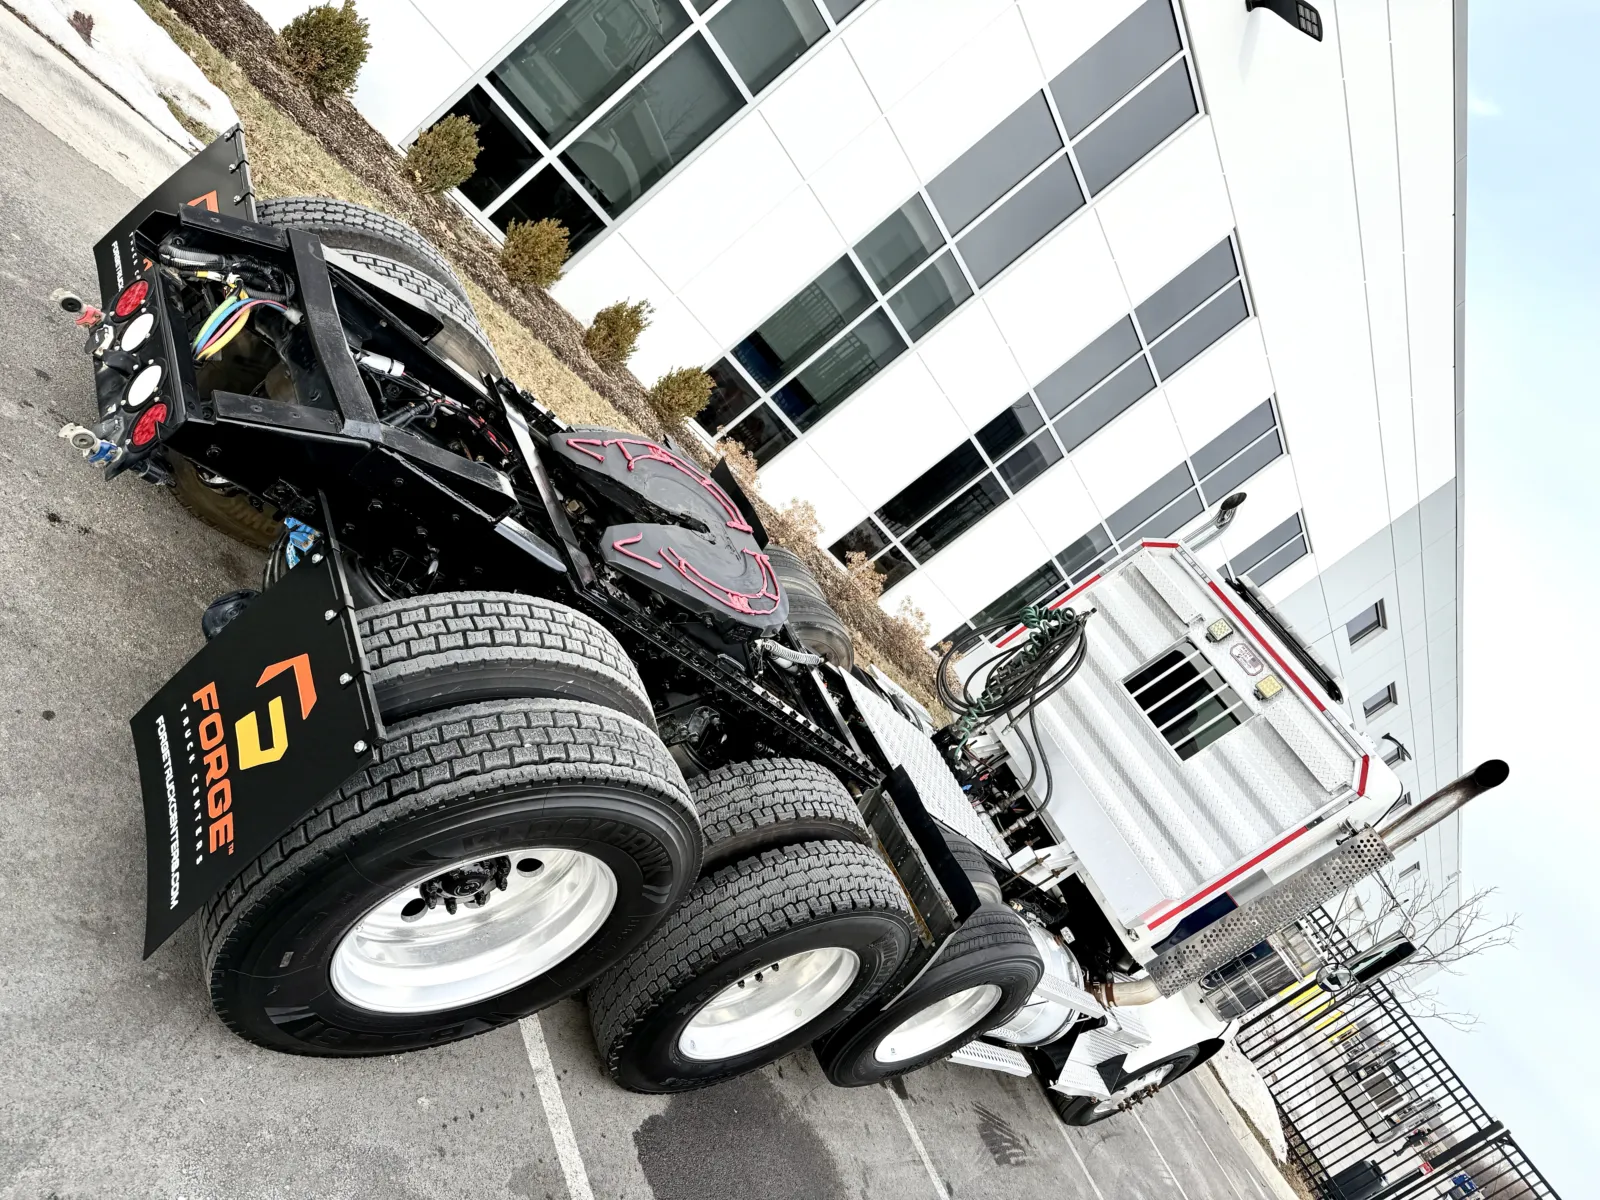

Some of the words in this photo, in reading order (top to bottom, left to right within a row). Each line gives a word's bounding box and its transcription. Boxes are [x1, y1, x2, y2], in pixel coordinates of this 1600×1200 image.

[155, 715, 180, 910] FORGETRUCKCENTERS.COM
[180, 703, 196, 764] TRUCK
[191, 773, 203, 865] CENTERS
[192, 681, 234, 854] FORGE
